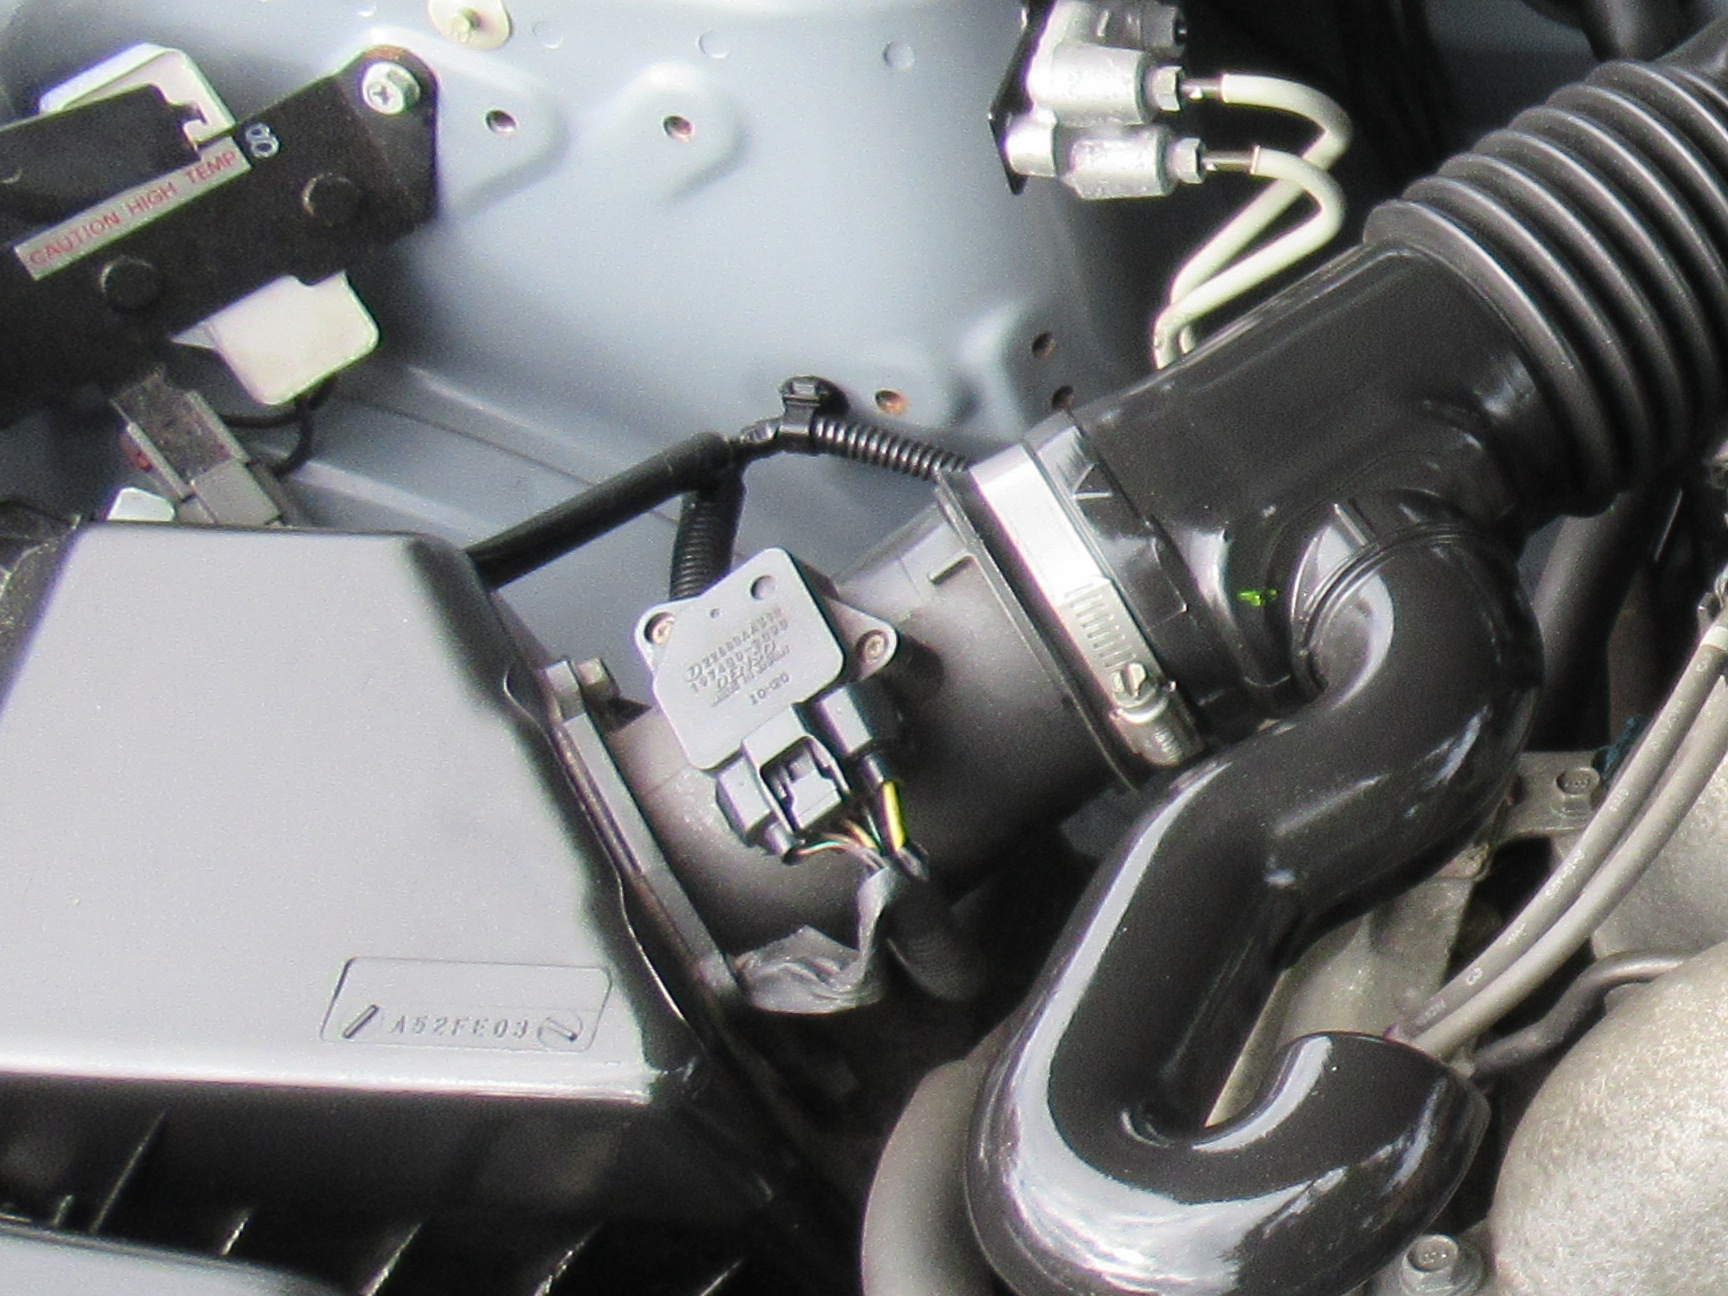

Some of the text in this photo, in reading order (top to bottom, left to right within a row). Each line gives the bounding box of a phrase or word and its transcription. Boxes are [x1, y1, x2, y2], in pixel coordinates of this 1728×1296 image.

[28, 150, 237, 266] CAUTION HIGH TEMP
